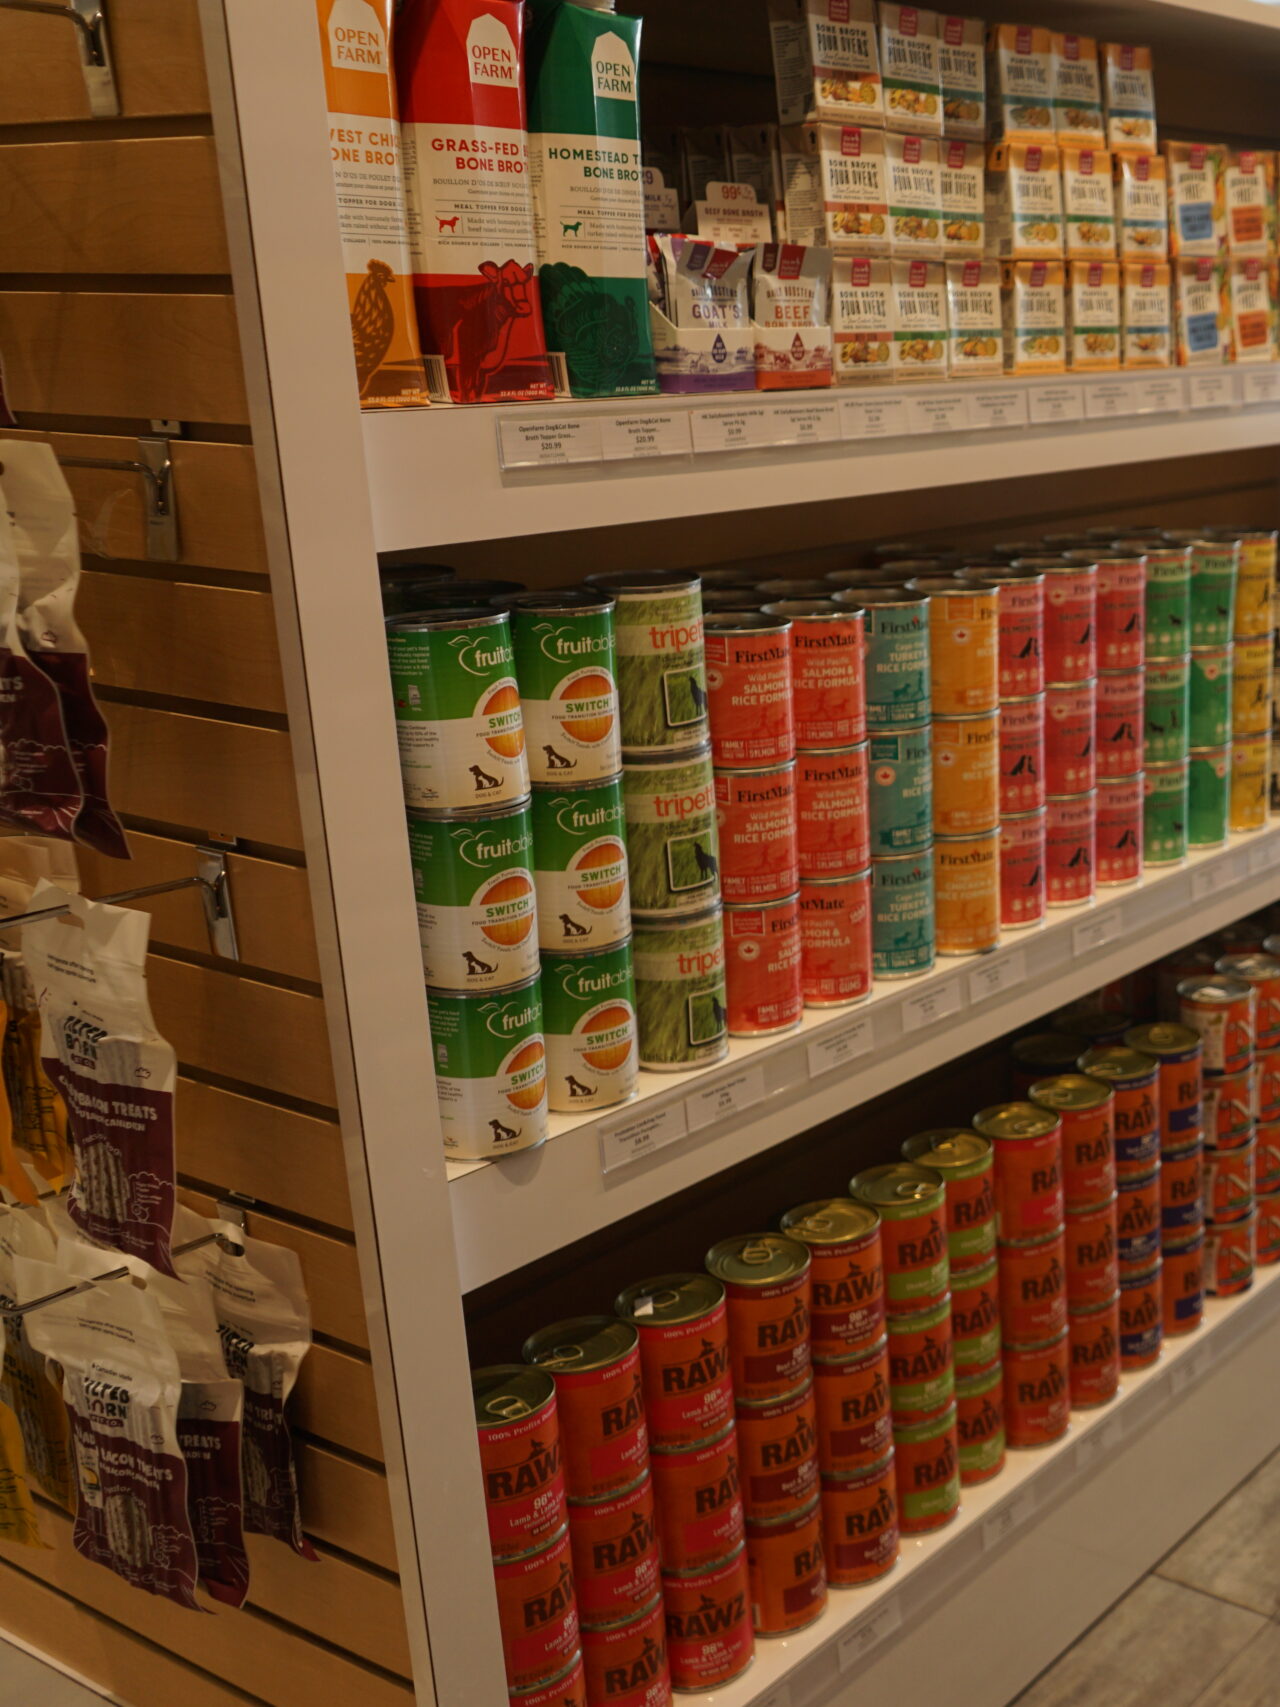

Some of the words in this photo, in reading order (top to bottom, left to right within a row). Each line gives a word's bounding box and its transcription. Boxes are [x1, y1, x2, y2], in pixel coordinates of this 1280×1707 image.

[335, 27, 380, 46] OPEN
[336, 45, 381, 65] FARM
[472, 45, 511, 63] OPEN
[473, 62, 513, 80] FARM
[596, 61, 631, 77] OPEN
[597, 76, 632, 94] FARM
[431, 138, 519, 156] GRASS-FED
[548, 147, 629, 164] HOMESTEAD
[456, 157, 494, 171] BONE
[583, 166, 614, 179] BONE
[433, 178, 469, 186] BOUILLON
[692, 303, 741, 319] GOAT'S
[775, 305, 810, 320] BEEF
[541, 441, 562, 451] $20.99
[635, 435, 655, 443] $20.99
[802, 667, 846, 678] SALMON
[876, 663, 899, 673] RICE
[565, 699, 610, 713] SWITCH
[732, 695, 757, 706] RICE
[801, 811, 825, 821] RICE
[734, 832, 759, 844] RICE
[581, 866, 621, 882] SWITCH
[486, 900, 529, 918] SWITCH
[877, 911, 899, 922] RICE
[587, 1027, 628, 1045] SWITCH
[112, 1101, 158, 1121] TREATS
[488, 1430, 511, 1443] 100%
[513, 1418, 541, 1436] Profits
[509, 1514, 532, 1528] Lamb
[524, 1559, 545, 1573] 100%
[667, 1594, 746, 1638] RAWZ
